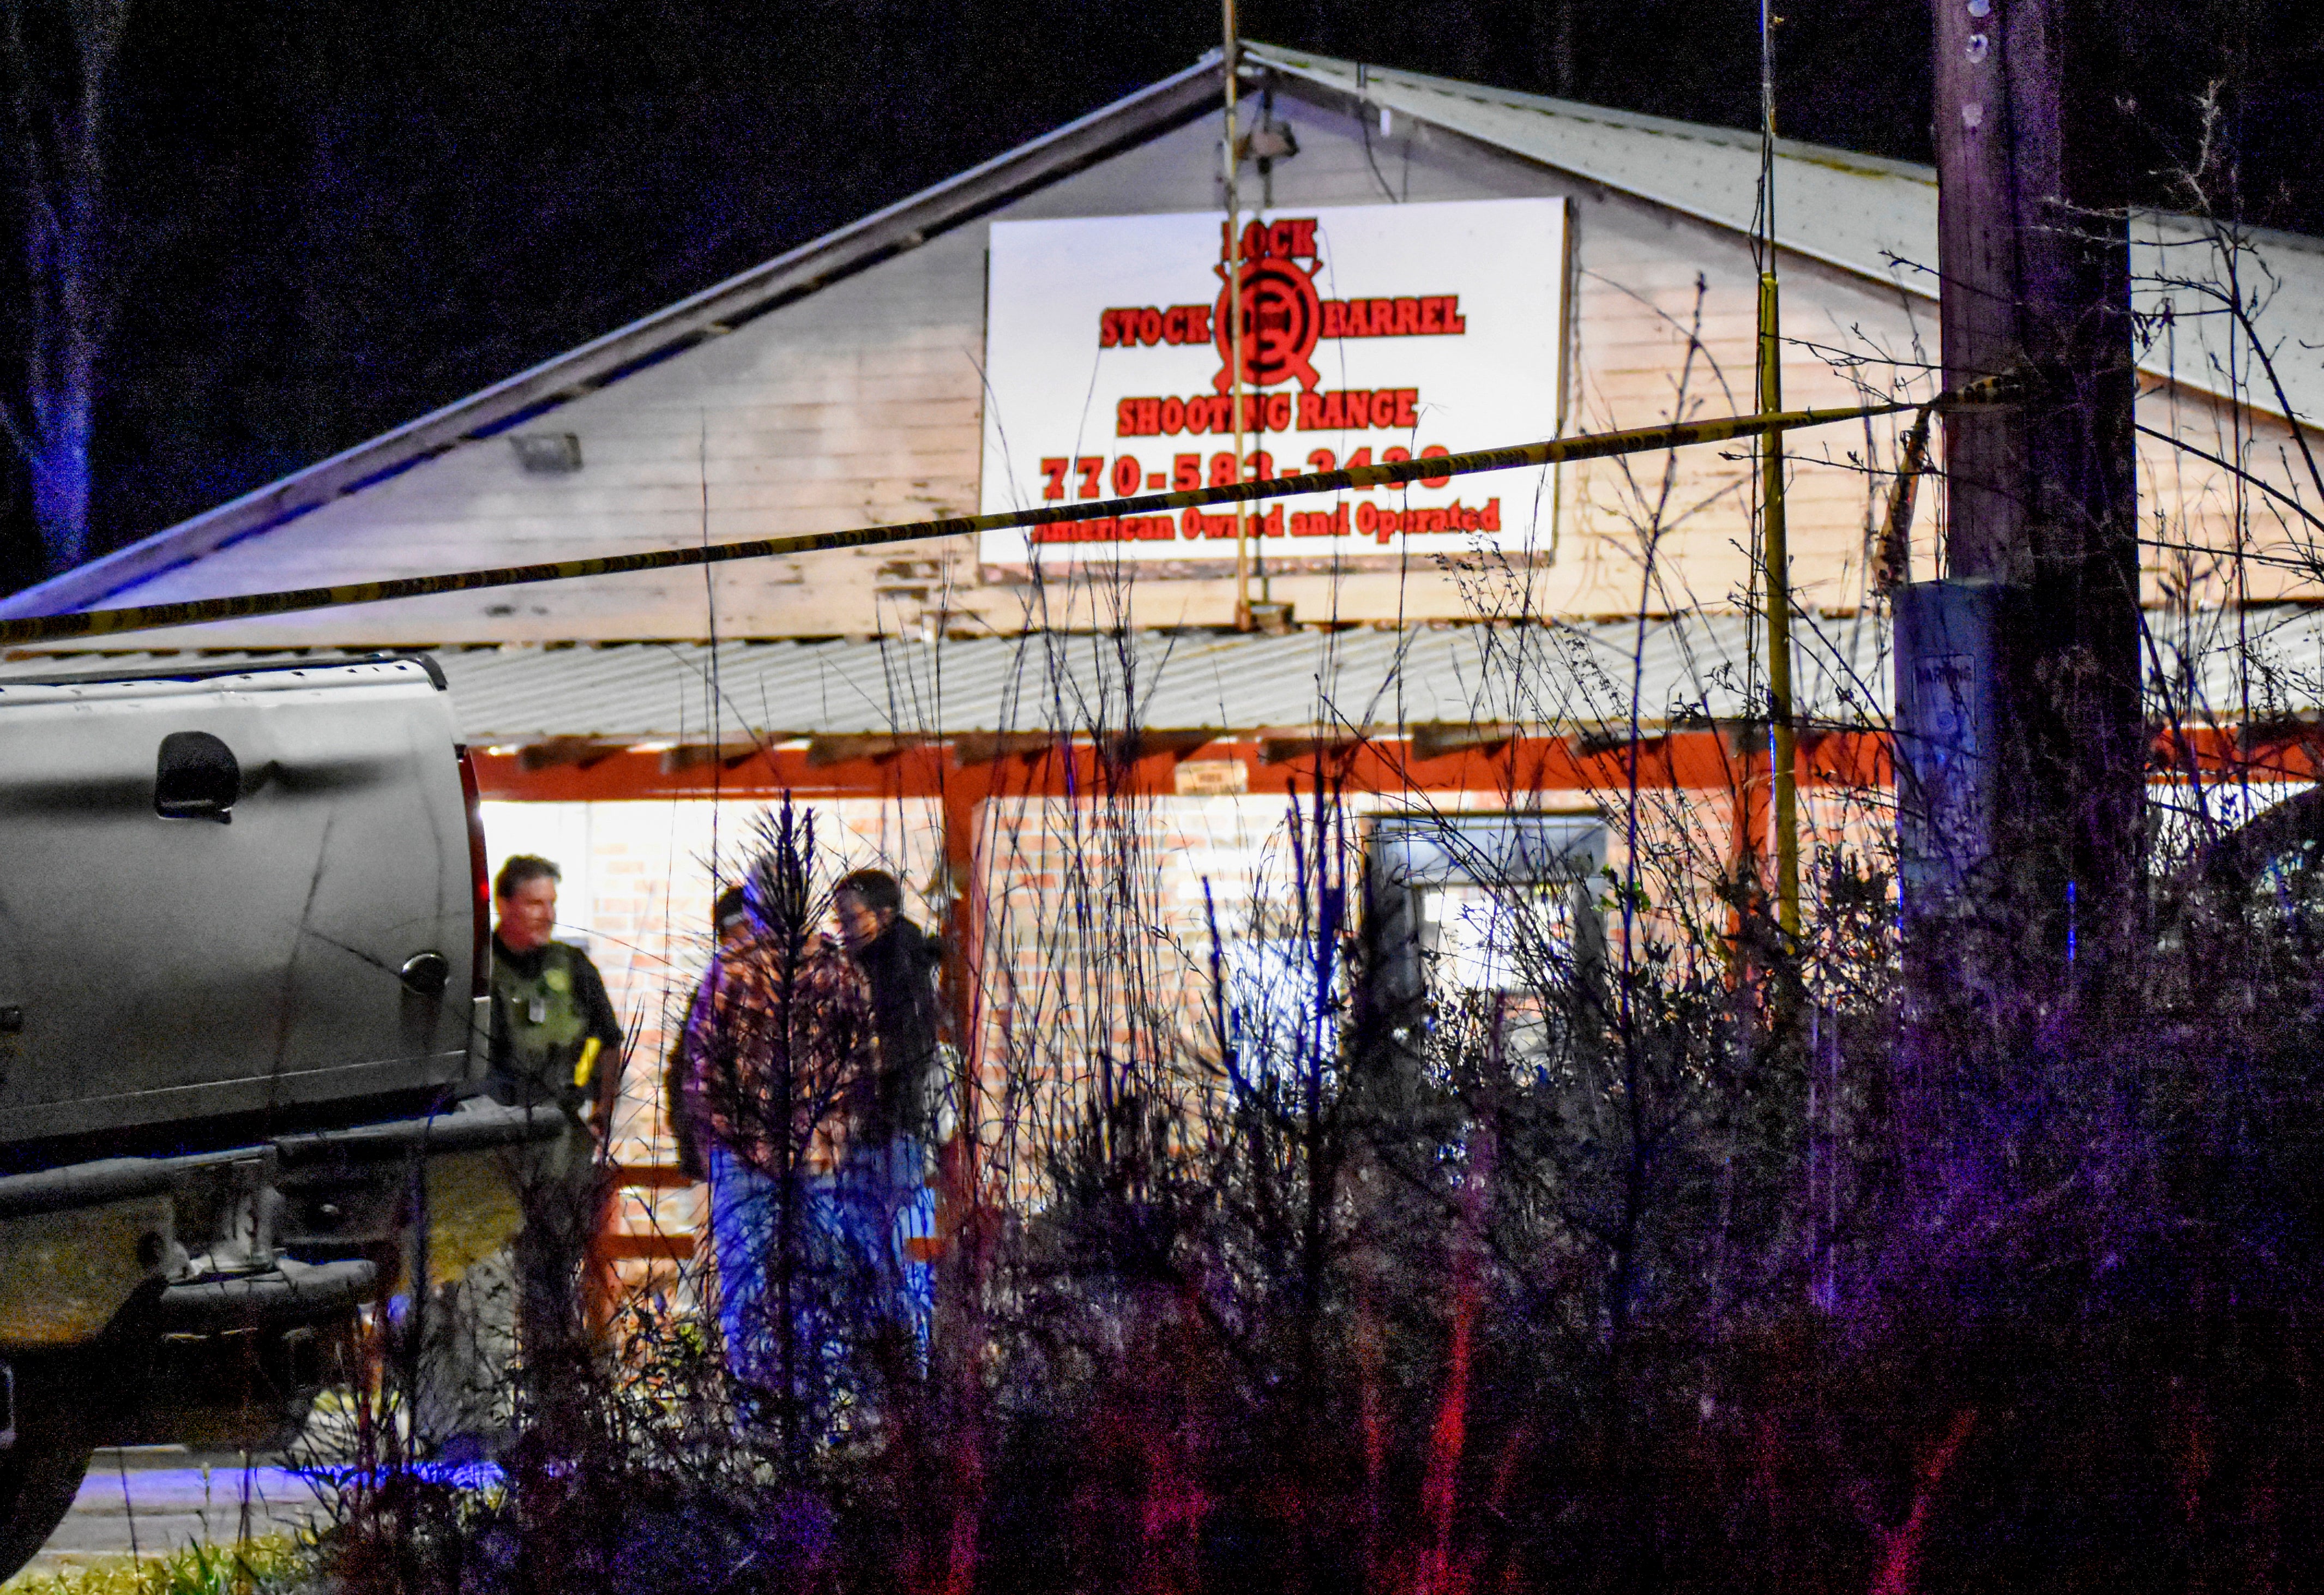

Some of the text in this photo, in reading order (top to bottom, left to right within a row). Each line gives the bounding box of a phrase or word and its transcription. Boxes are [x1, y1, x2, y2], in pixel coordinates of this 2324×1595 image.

[1222, 219, 1317, 261] LOCK
[1100, 295, 1466, 348] STOCK BARREL
[1296, 388, 1418, 431] RANGE
[1289, 502, 1351, 538] and
[1356, 497, 1501, 545] Operated
